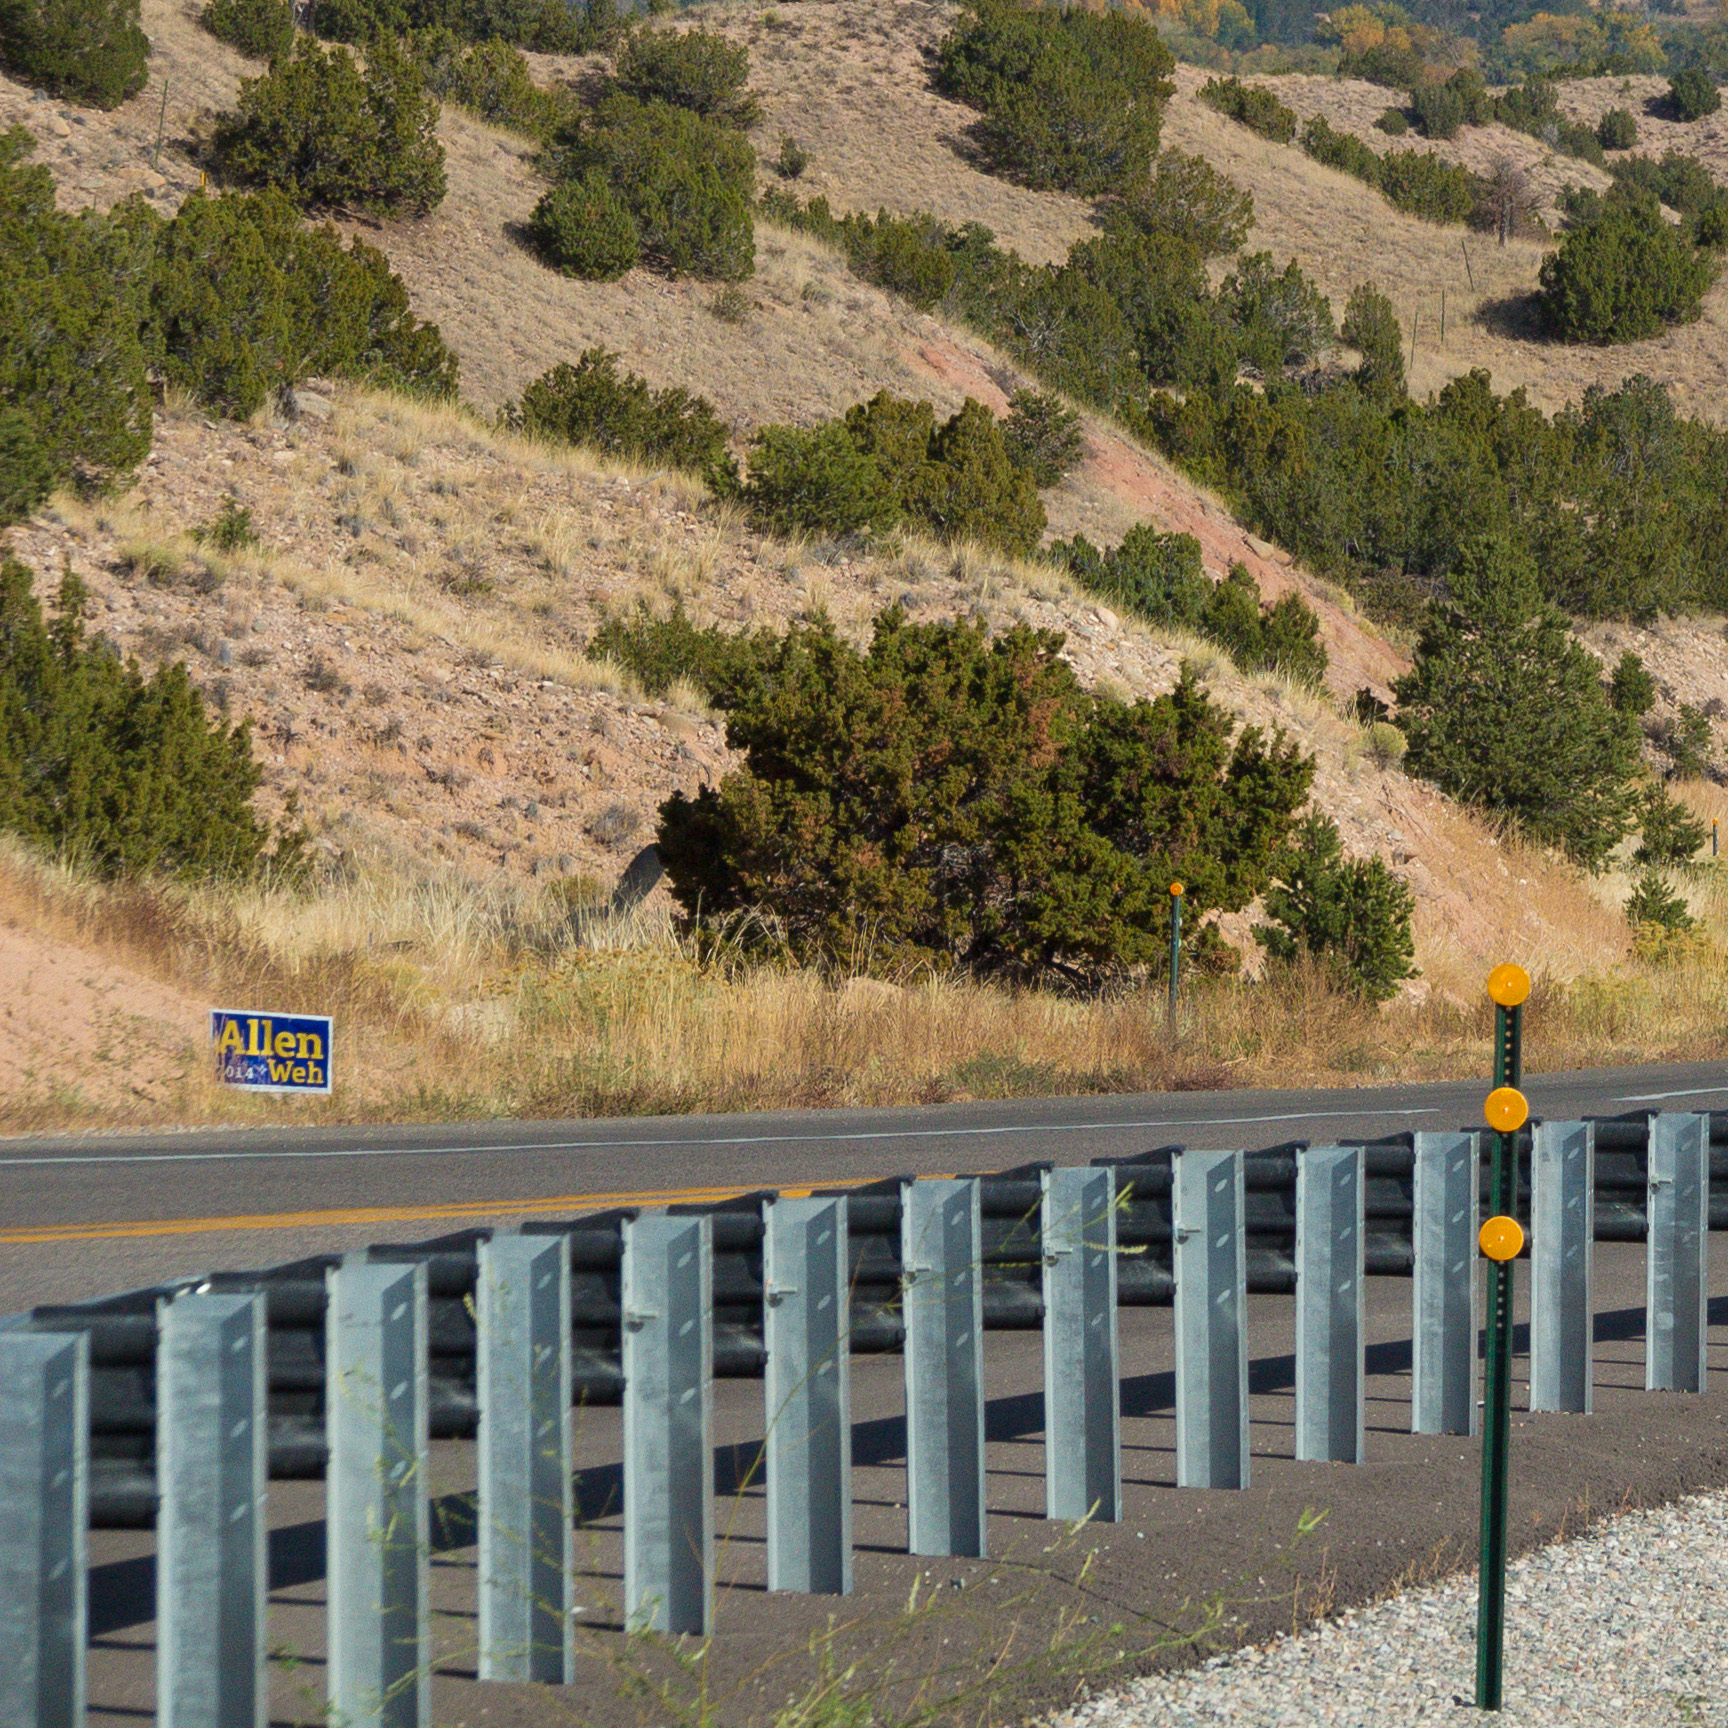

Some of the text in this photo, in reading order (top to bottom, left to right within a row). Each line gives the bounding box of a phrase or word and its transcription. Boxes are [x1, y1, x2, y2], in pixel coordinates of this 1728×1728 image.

[219, 1019, 324, 1059] Allen
[221, 1065, 254, 1079] 014
[267, 1058, 324, 1083] Weh
